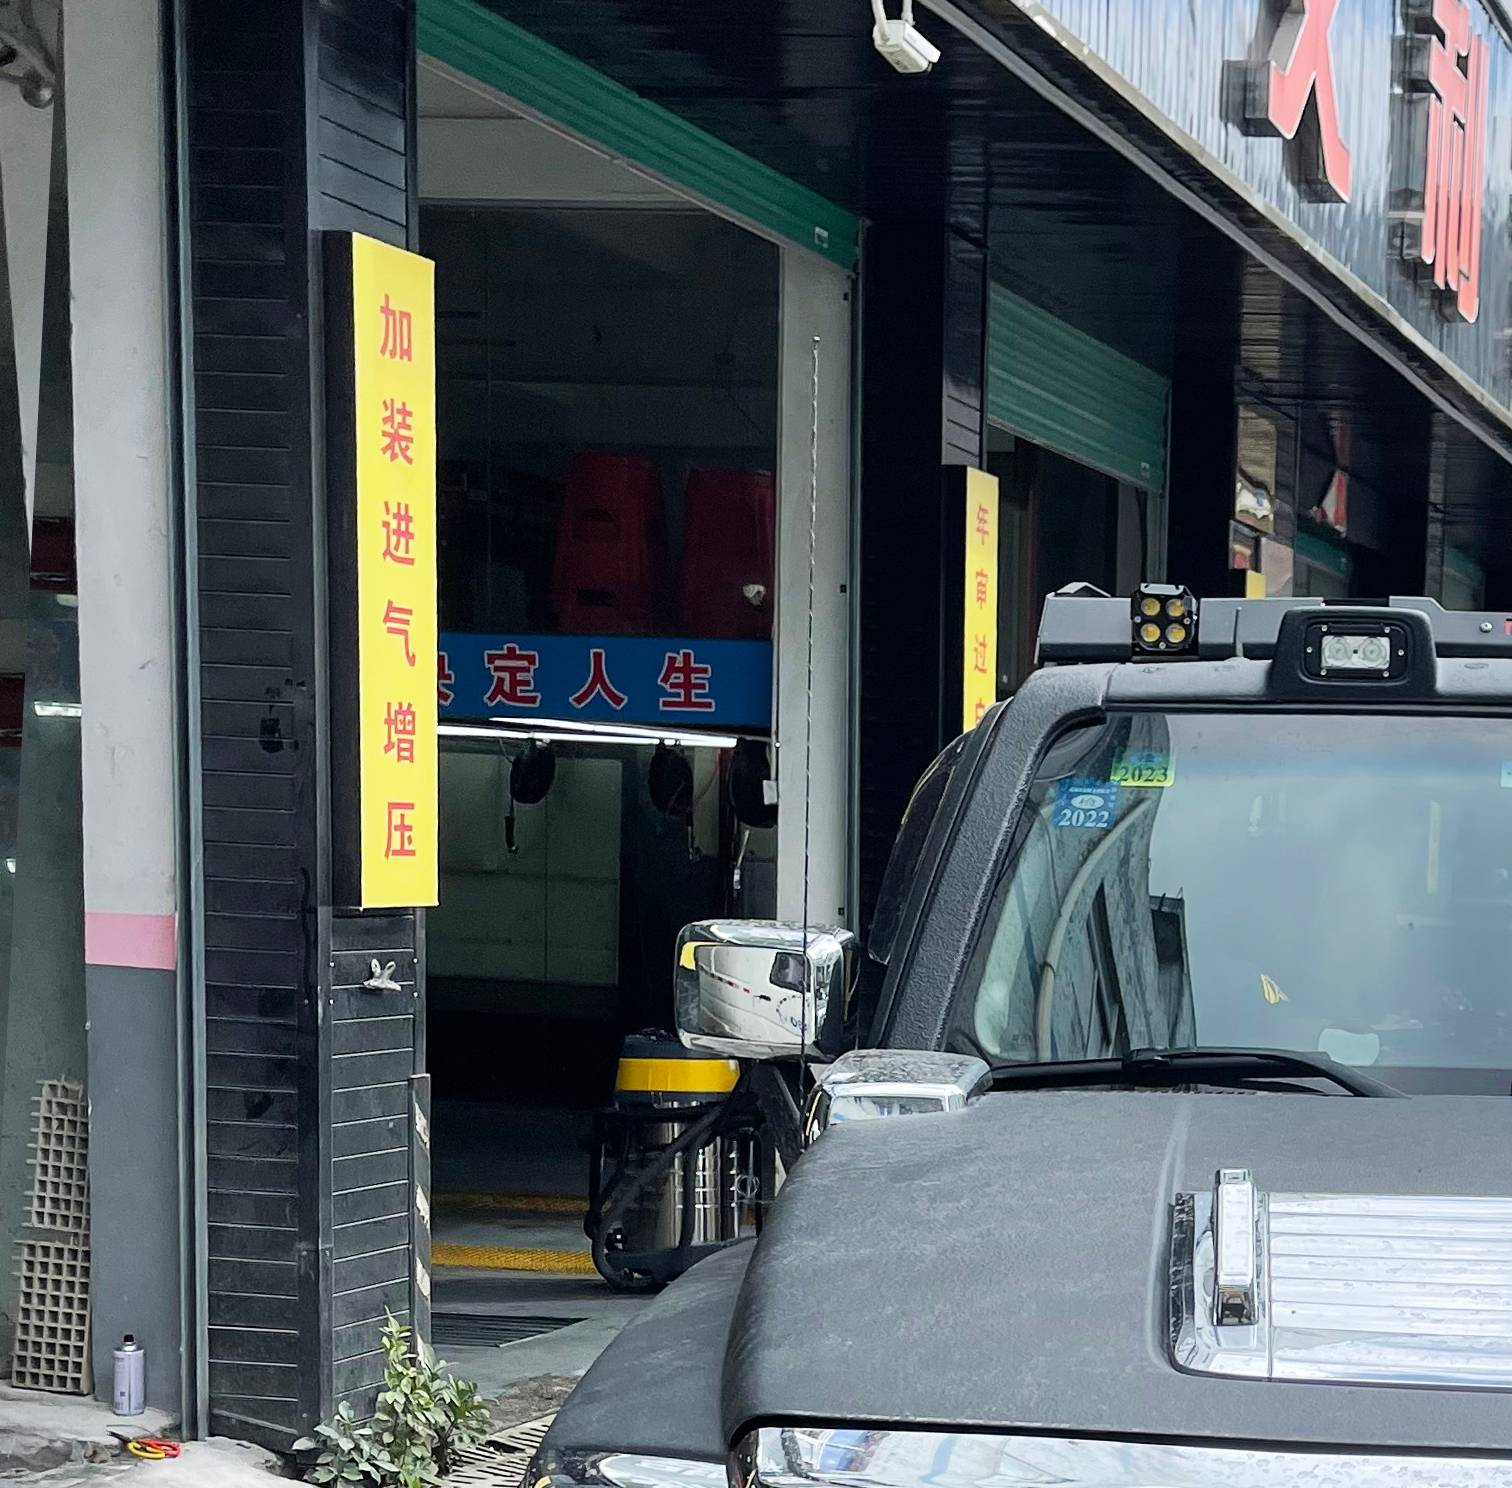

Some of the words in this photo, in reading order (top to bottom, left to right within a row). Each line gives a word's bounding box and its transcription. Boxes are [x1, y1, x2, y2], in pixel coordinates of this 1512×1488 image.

[379, 294, 417, 860] 加装进气增压
[1120, 766, 1168, 782] 2023
[1058, 808, 1110, 828] 2022
